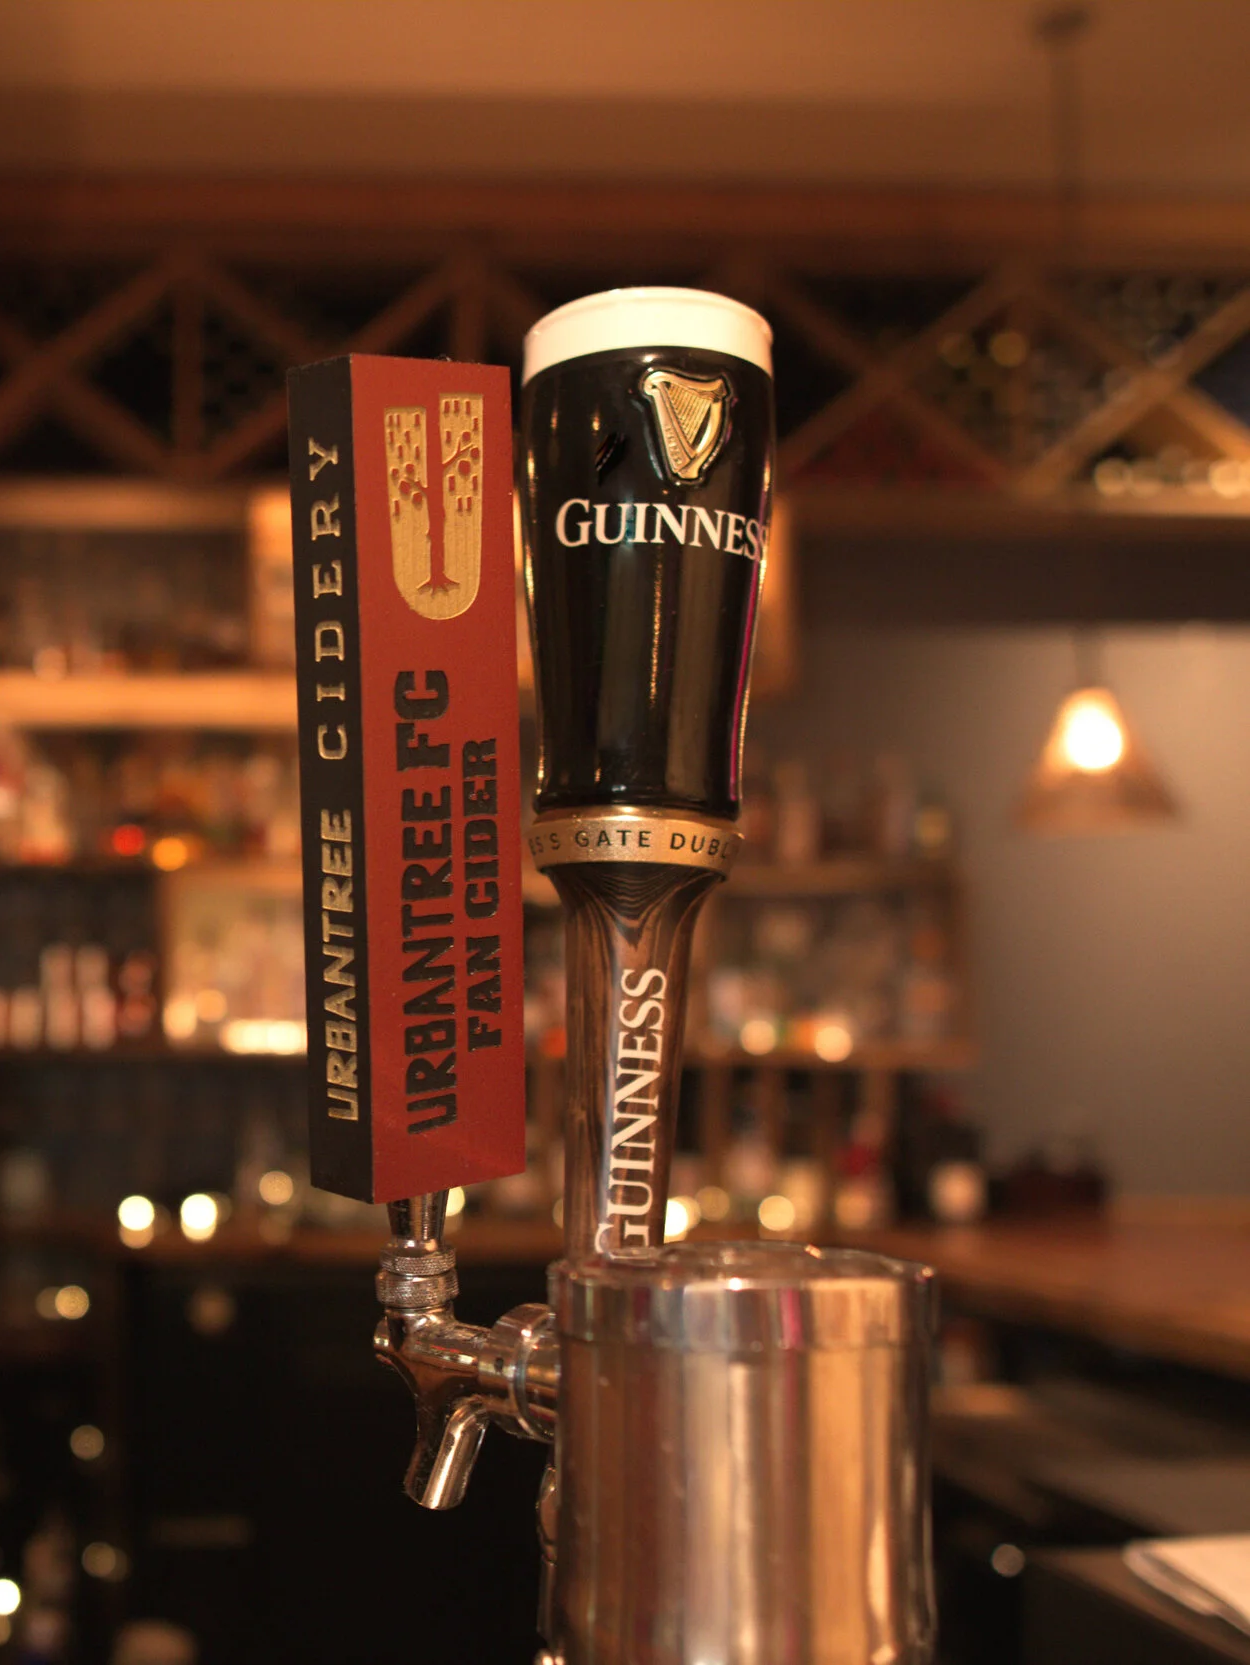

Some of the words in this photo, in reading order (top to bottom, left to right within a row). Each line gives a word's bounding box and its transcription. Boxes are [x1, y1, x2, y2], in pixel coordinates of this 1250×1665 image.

[308, 437, 348, 760] CIDERY
[555, 498, 769, 561] GUINNESS
[393, 669, 451, 772] FC
[462, 738, 500, 919] CIDER
[575, 829, 652, 849] GATE
[321, 808, 358, 1121] URBANTREE
[401, 786, 457, 1135] URBANTREE
[466, 935, 502, 1053] FAN
[594, 968, 668, 1254] GUINNESS
